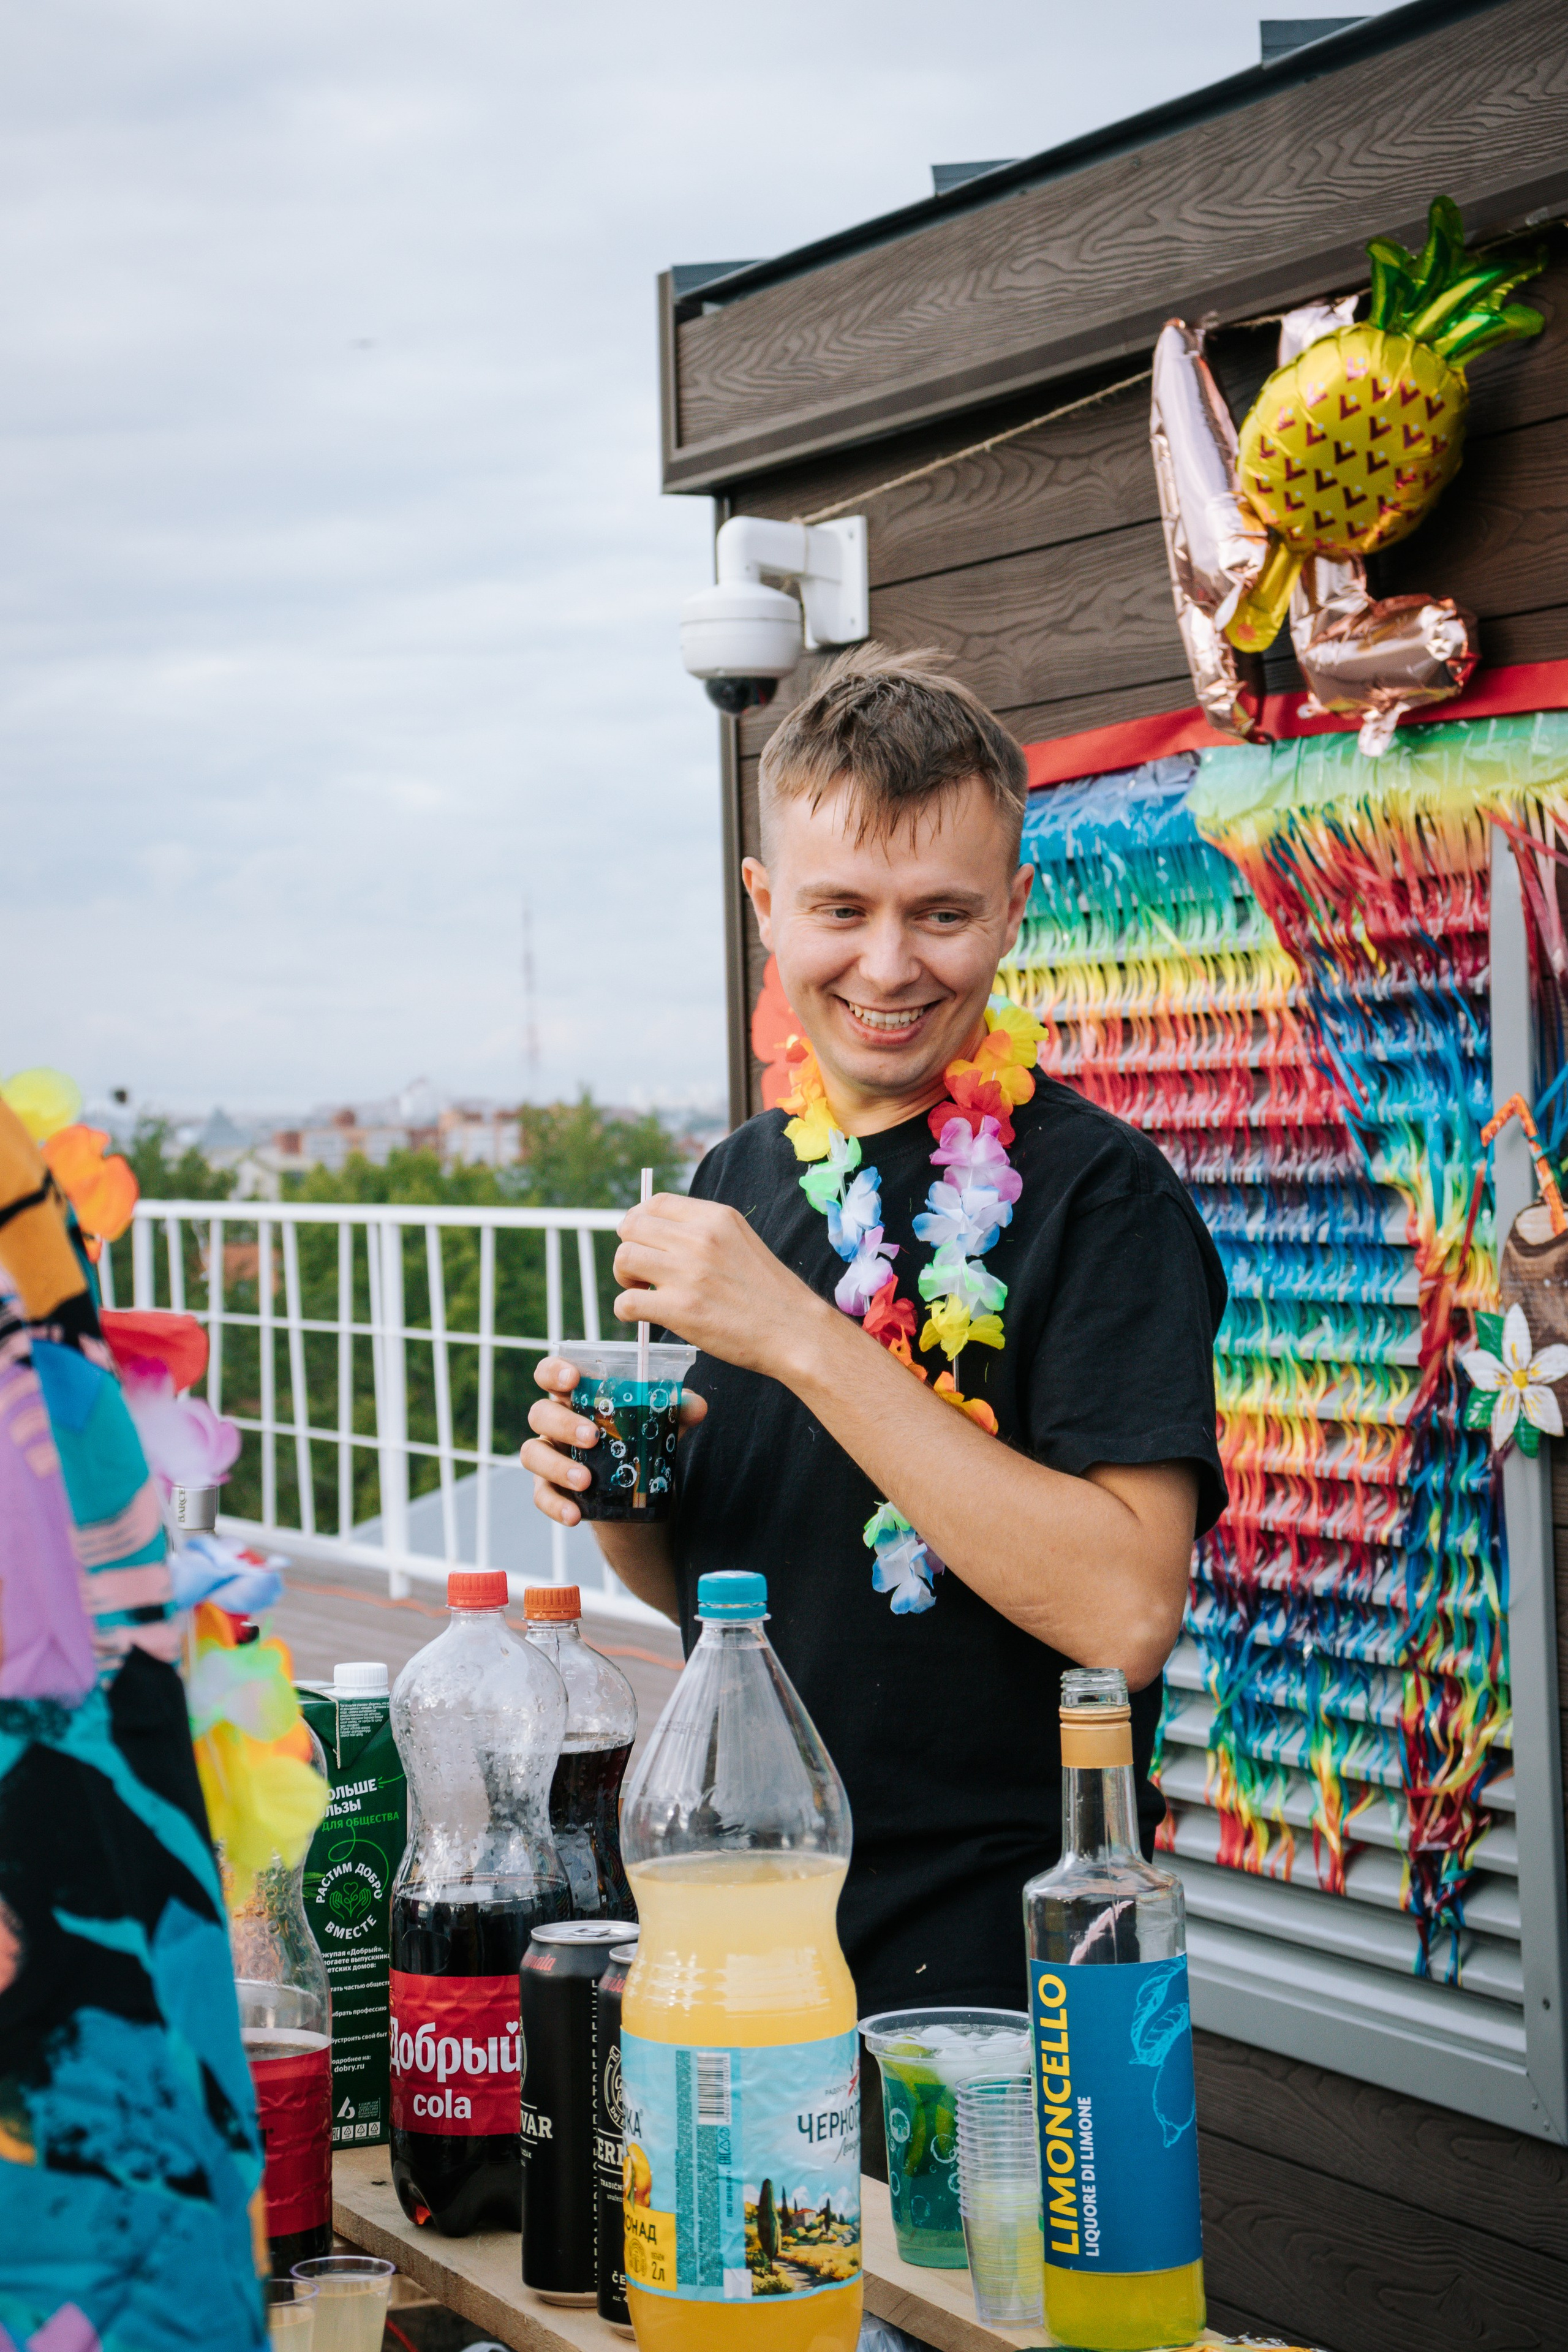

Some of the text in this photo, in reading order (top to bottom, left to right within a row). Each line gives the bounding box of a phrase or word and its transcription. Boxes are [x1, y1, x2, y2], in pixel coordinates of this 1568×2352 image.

[326, 1779, 377, 1801] ОЛЬШЕ
[322, 1812, 399, 1832] ДЛЯ ОБЩЕСТВА
[315, 1862, 383, 1903] РАСТИМ ДОБРО
[325, 1915, 377, 1939] ВМЕСТЕ
[322, 1950, 345, 1959] окупая
[353, 2006, 387, 2015] профессию
[331, 2035, 361, 2044] бустроить
[390, 2016, 521, 2082] Добрый
[331, 2056, 361, 2065] одробнее
[334, 2064, 365, 2073] dobry.ru
[413, 2089, 472, 2119] cola
[1038, 1974, 1079, 2254] LIMONCELLO
[1077, 2097, 1100, 2256] LIQUORE DI LIMONE
[625, 2214, 657, 2245] ОНАД
